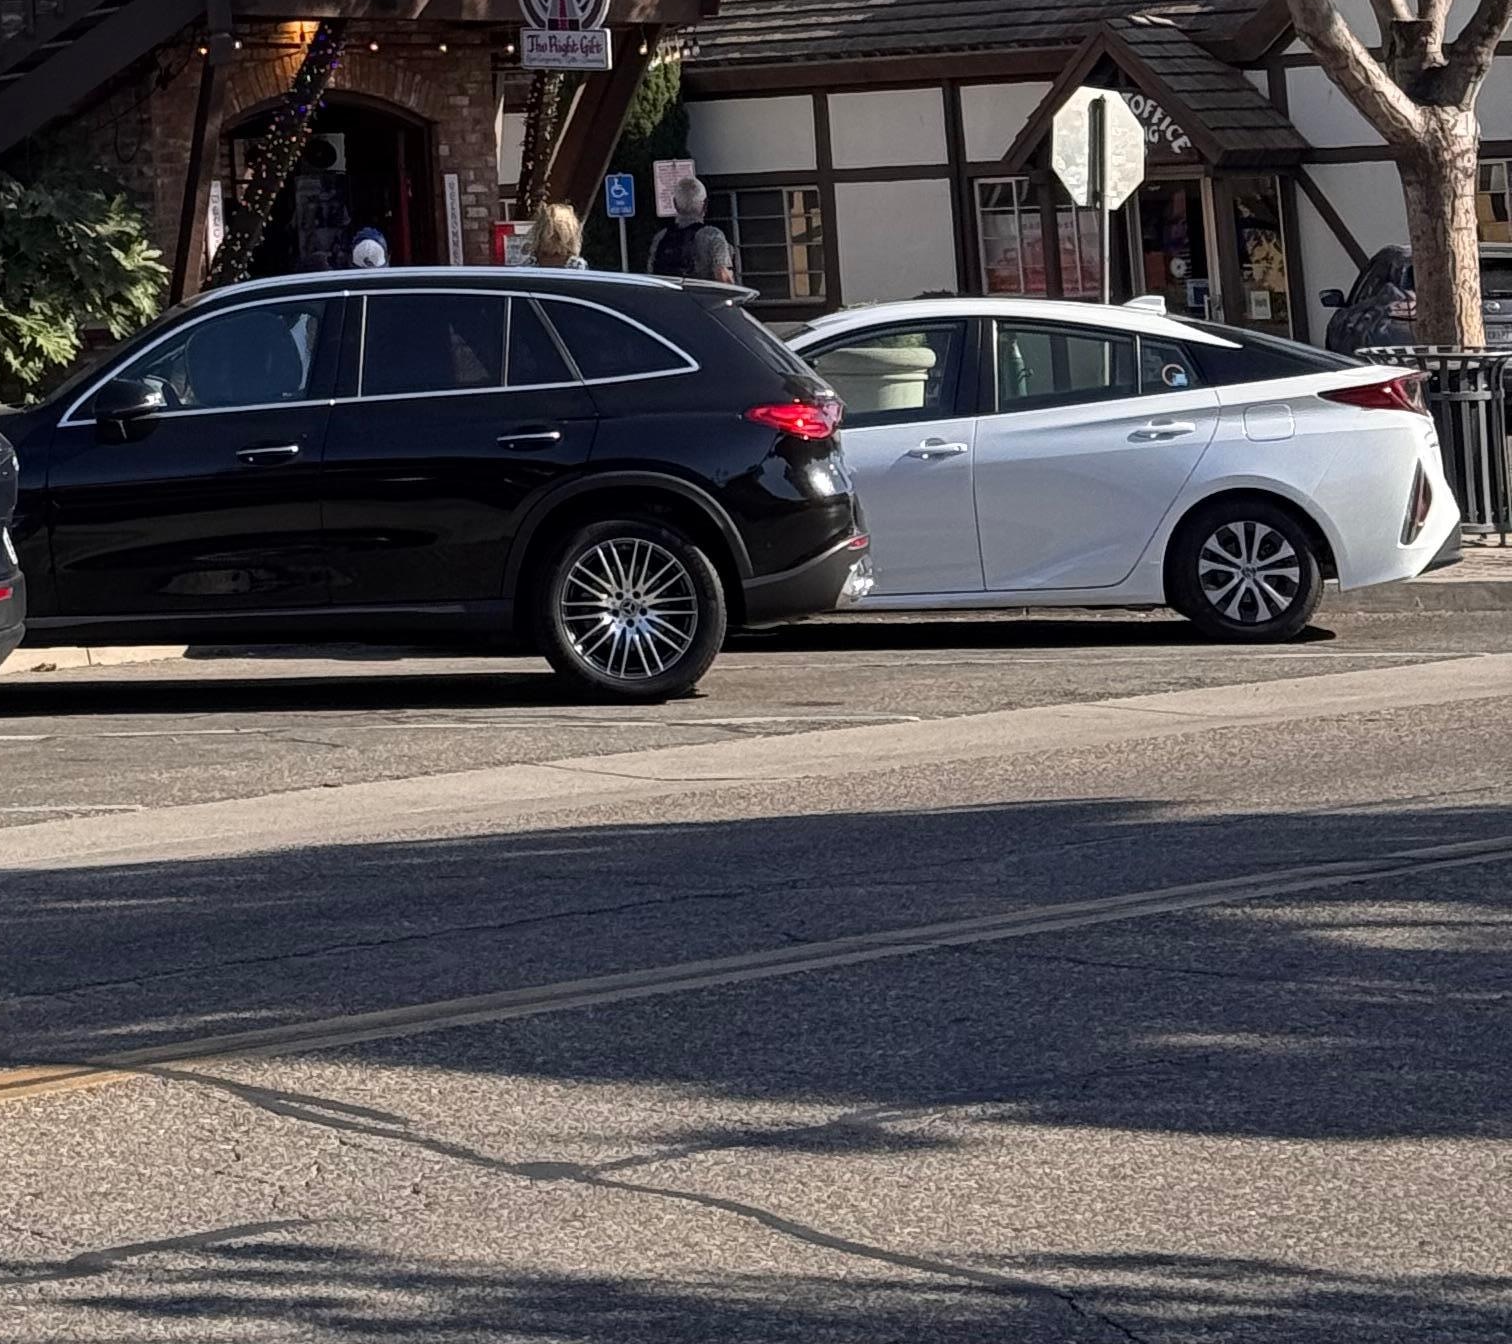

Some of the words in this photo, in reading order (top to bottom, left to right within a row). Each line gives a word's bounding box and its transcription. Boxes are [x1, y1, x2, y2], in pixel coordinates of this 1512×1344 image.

[526, 34, 548, 53] The
[548, 34, 579, 57] Right
[580, 34, 603, 57] Gift
